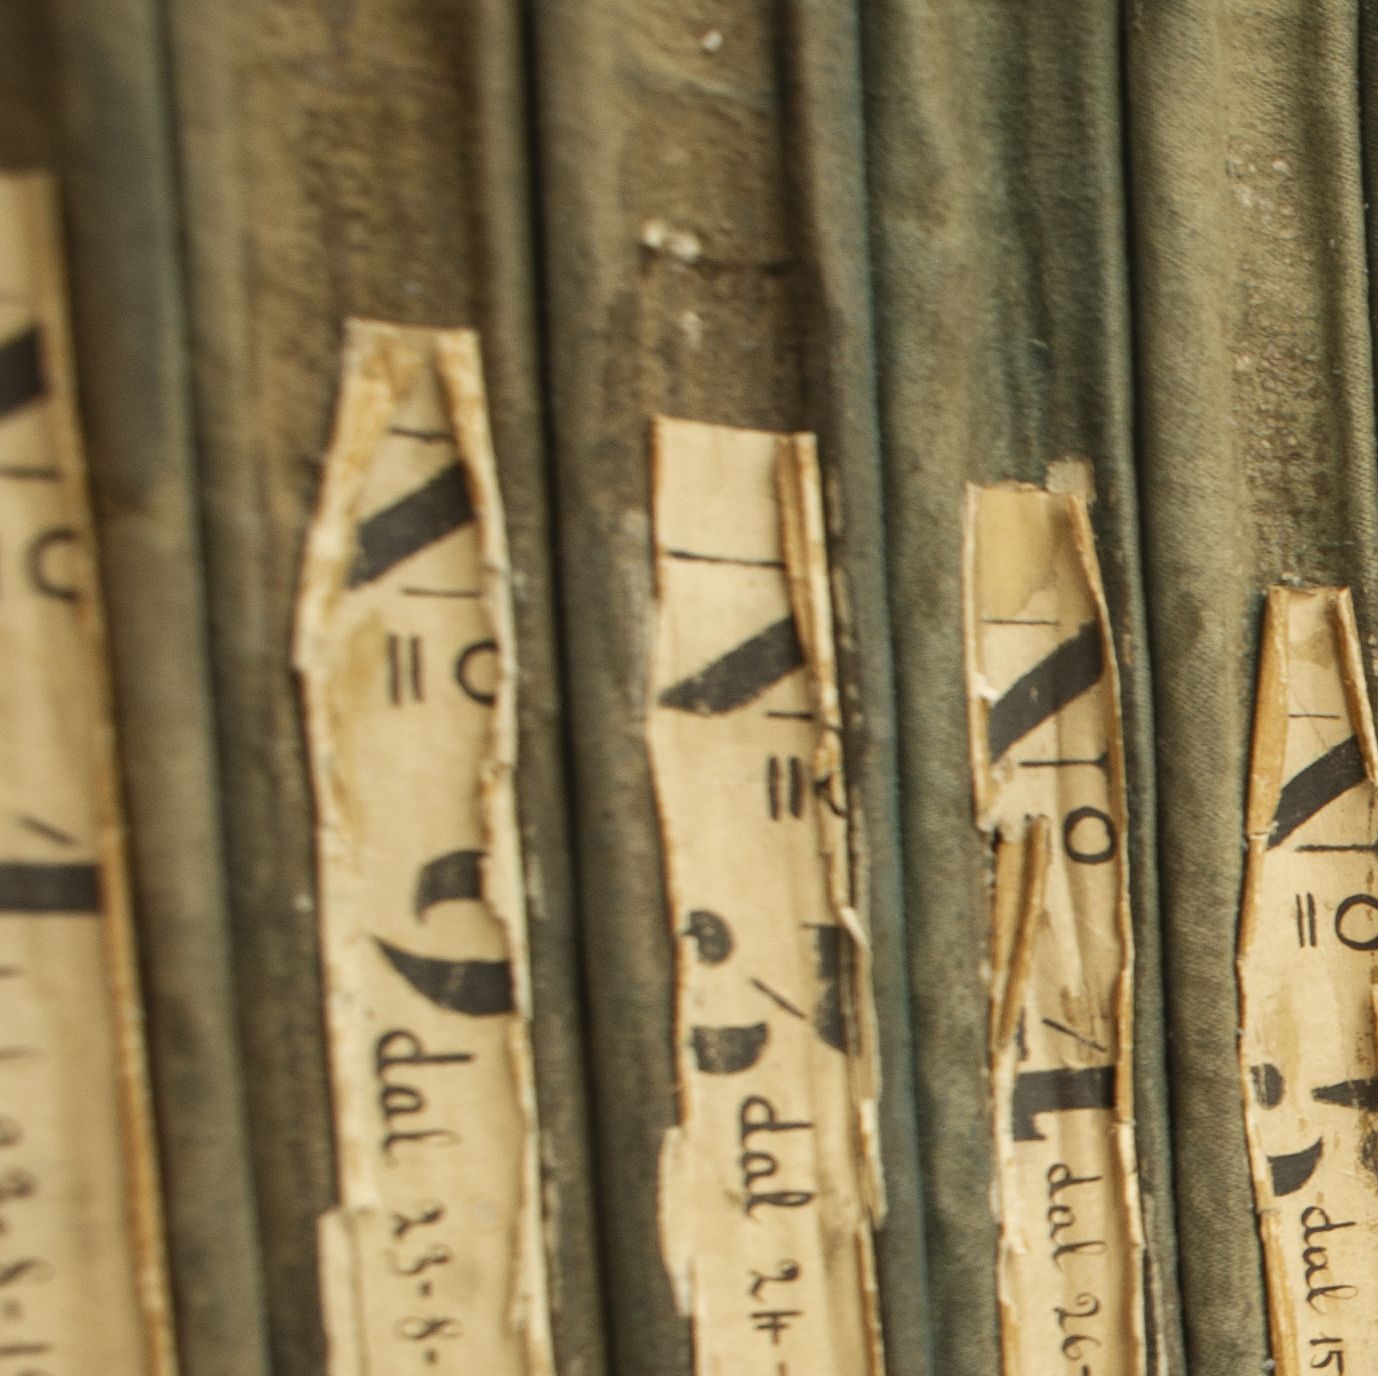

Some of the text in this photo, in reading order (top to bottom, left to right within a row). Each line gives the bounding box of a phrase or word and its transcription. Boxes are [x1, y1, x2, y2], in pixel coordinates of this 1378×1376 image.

[374, 1029, 477, 1162] dal
[738, 1094, 815, 1223] dal
[1045, 1161, 1107, 1275] dal
[1299, 1206, 1356, 1311] dal
